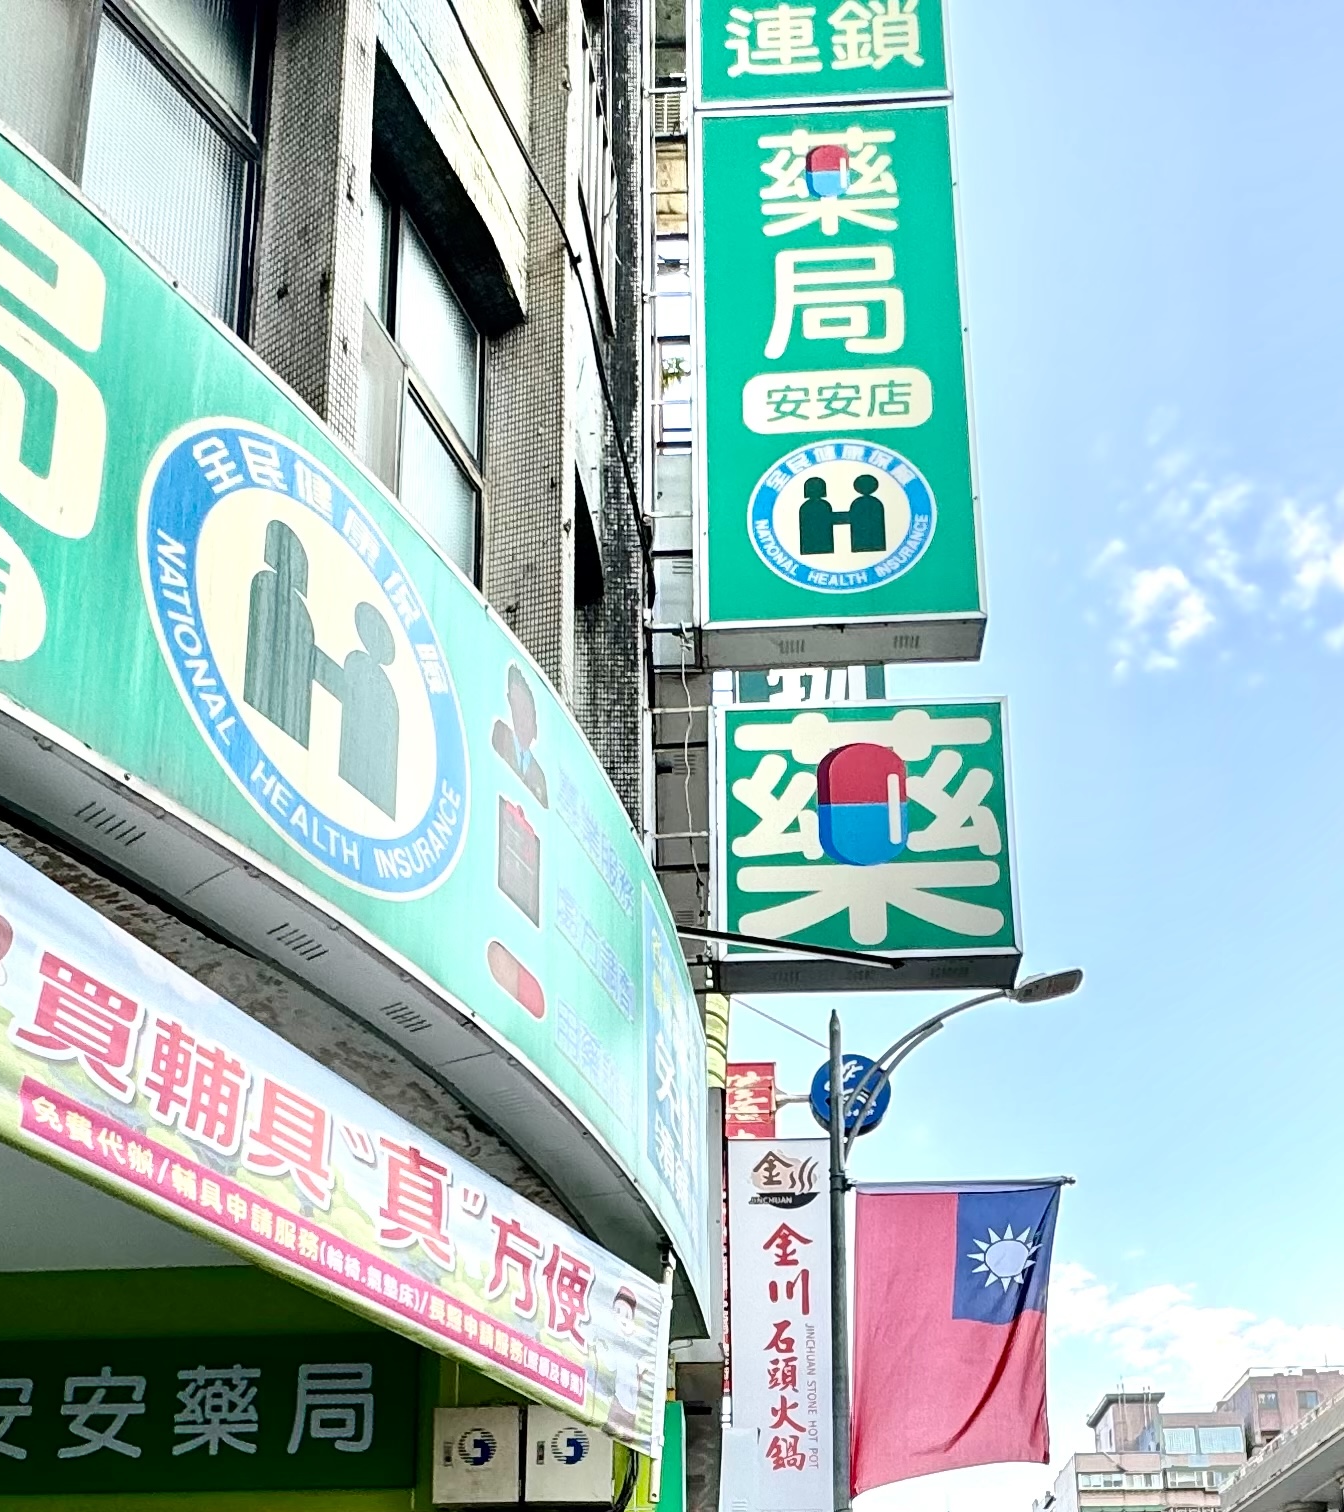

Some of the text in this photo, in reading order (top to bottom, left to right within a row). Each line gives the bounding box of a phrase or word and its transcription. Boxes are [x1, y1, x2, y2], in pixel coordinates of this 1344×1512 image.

[724, 0, 925, 78] 連鎖
[757, 126, 906, 360] 藥局
[766, 380, 913, 423] 安安店
[754, 512, 930, 587] NATIONAL HEALTH INSURANCE
[156, 527, 463, 881] NATIONAL HEALTH INSURANCE
[731, 708, 1006, 947] 藥
[762, 1222, 814, 1472] 金川石頭火鍋
[805, 1322, 819, 1469] JINCHUAN STONE HOT POT
